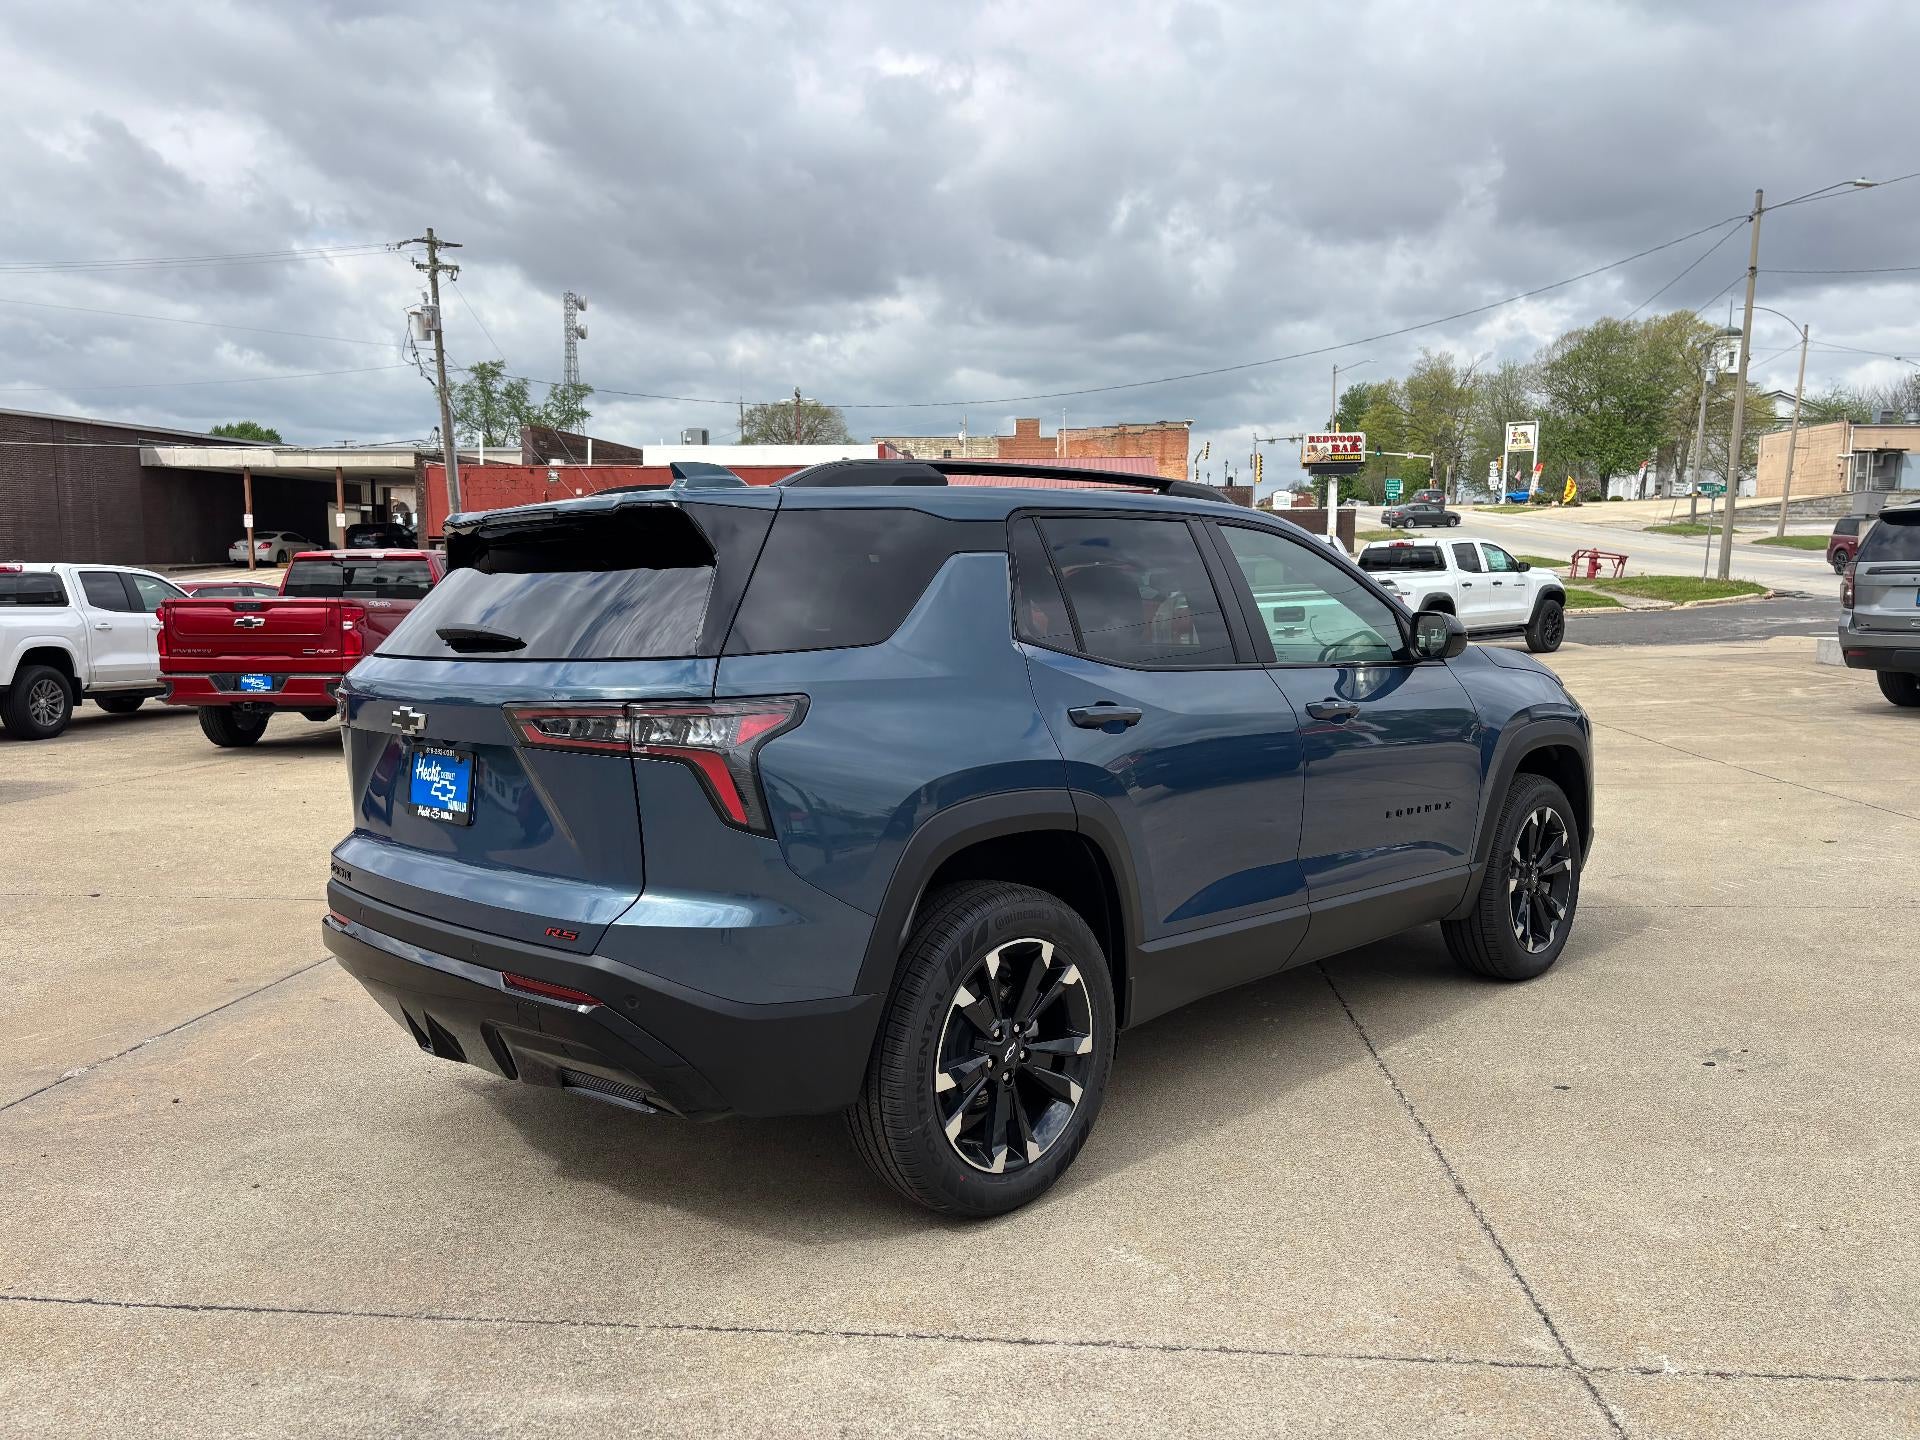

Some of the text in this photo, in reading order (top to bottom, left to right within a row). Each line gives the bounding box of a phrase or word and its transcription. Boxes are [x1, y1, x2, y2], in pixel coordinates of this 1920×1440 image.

[1331, 444, 1361, 453] BAR
[416, 758, 441, 782] Hecht
[1385, 801, 1451, 819] EQUINOX
[545, 927, 580, 941] RS
